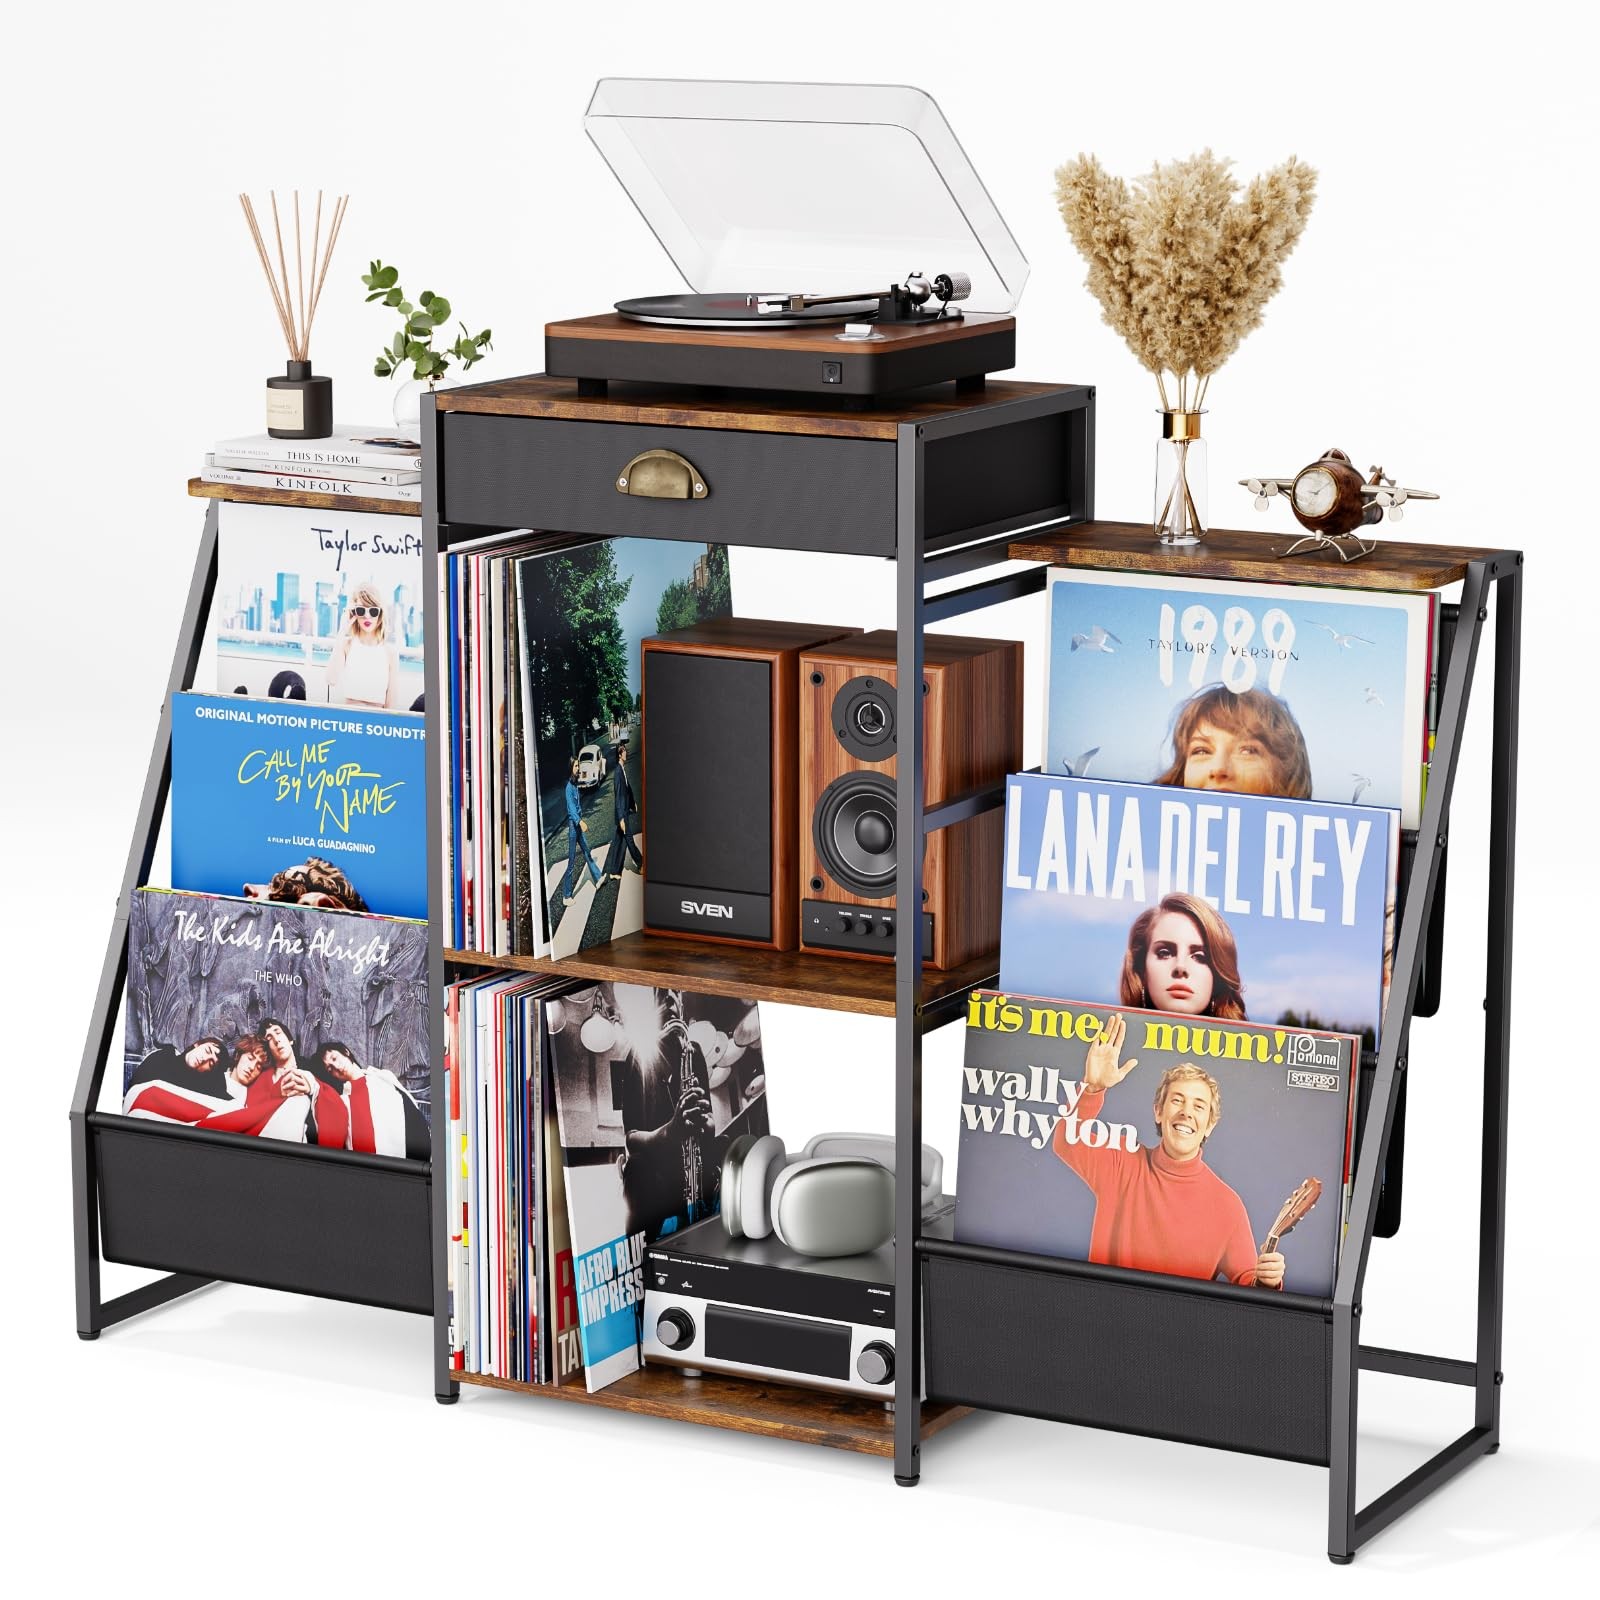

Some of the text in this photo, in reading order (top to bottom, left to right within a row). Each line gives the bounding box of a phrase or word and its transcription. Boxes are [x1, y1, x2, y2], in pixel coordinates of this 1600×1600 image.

[274, 464, 313, 473] KINFOLK
[287, 451, 361, 465] THIS IS HOME
[275, 477, 352, 493] KINFOLK
[311, 528, 422, 571] Taylor Swift
[1148, 638, 1300, 662] TAYLOR'S VERSION
[1159, 603, 1296, 696] 1989
[195, 707, 254, 723] ORIGINAL
[257, 713, 307, 729] MOTION
[311, 718, 362, 734] PICTURE
[238, 740, 336, 784] CALL ME
[308, 762, 381, 810] YOUR
[320, 781, 406, 834] NAME
[292, 835, 316, 848] LUCA
[317, 838, 376, 854] GUADAGNINO
[1006, 784, 1371, 926] LANA DEL REY
[680, 900, 734, 919] SVEN
[174, 910, 390, 974] The Kids Are Alright
[254, 969, 303, 987] THE WHO
[966, 993, 1024, 1032] it's
[1143, 1021, 1287, 1064] mum!
[964, 1064, 1089, 1118] wally
[1291, 1072, 1336, 1086] STEREO
[962, 1098, 1141, 1153] whyton
[579, 1247, 614, 1291] AFRO
[581, 1268, 645, 1328] IMPRESS
